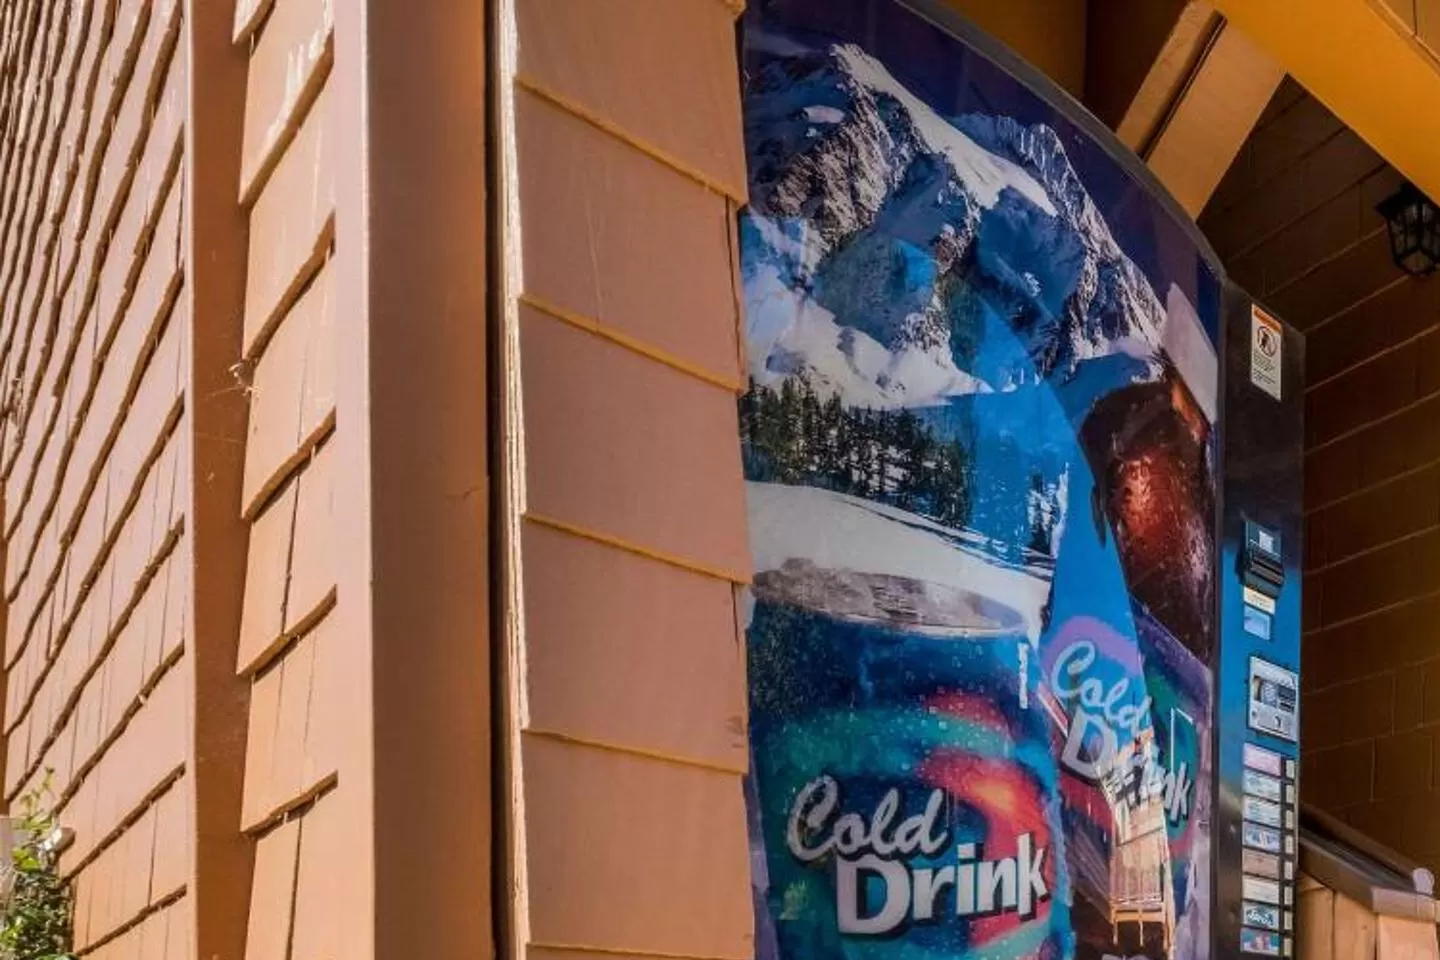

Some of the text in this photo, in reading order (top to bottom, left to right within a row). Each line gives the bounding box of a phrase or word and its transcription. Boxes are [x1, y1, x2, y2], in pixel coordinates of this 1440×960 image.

[1051, 640, 1152, 735] Cold
[787, 774, 947, 861] Cold
[836, 833, 1049, 935] Drink
